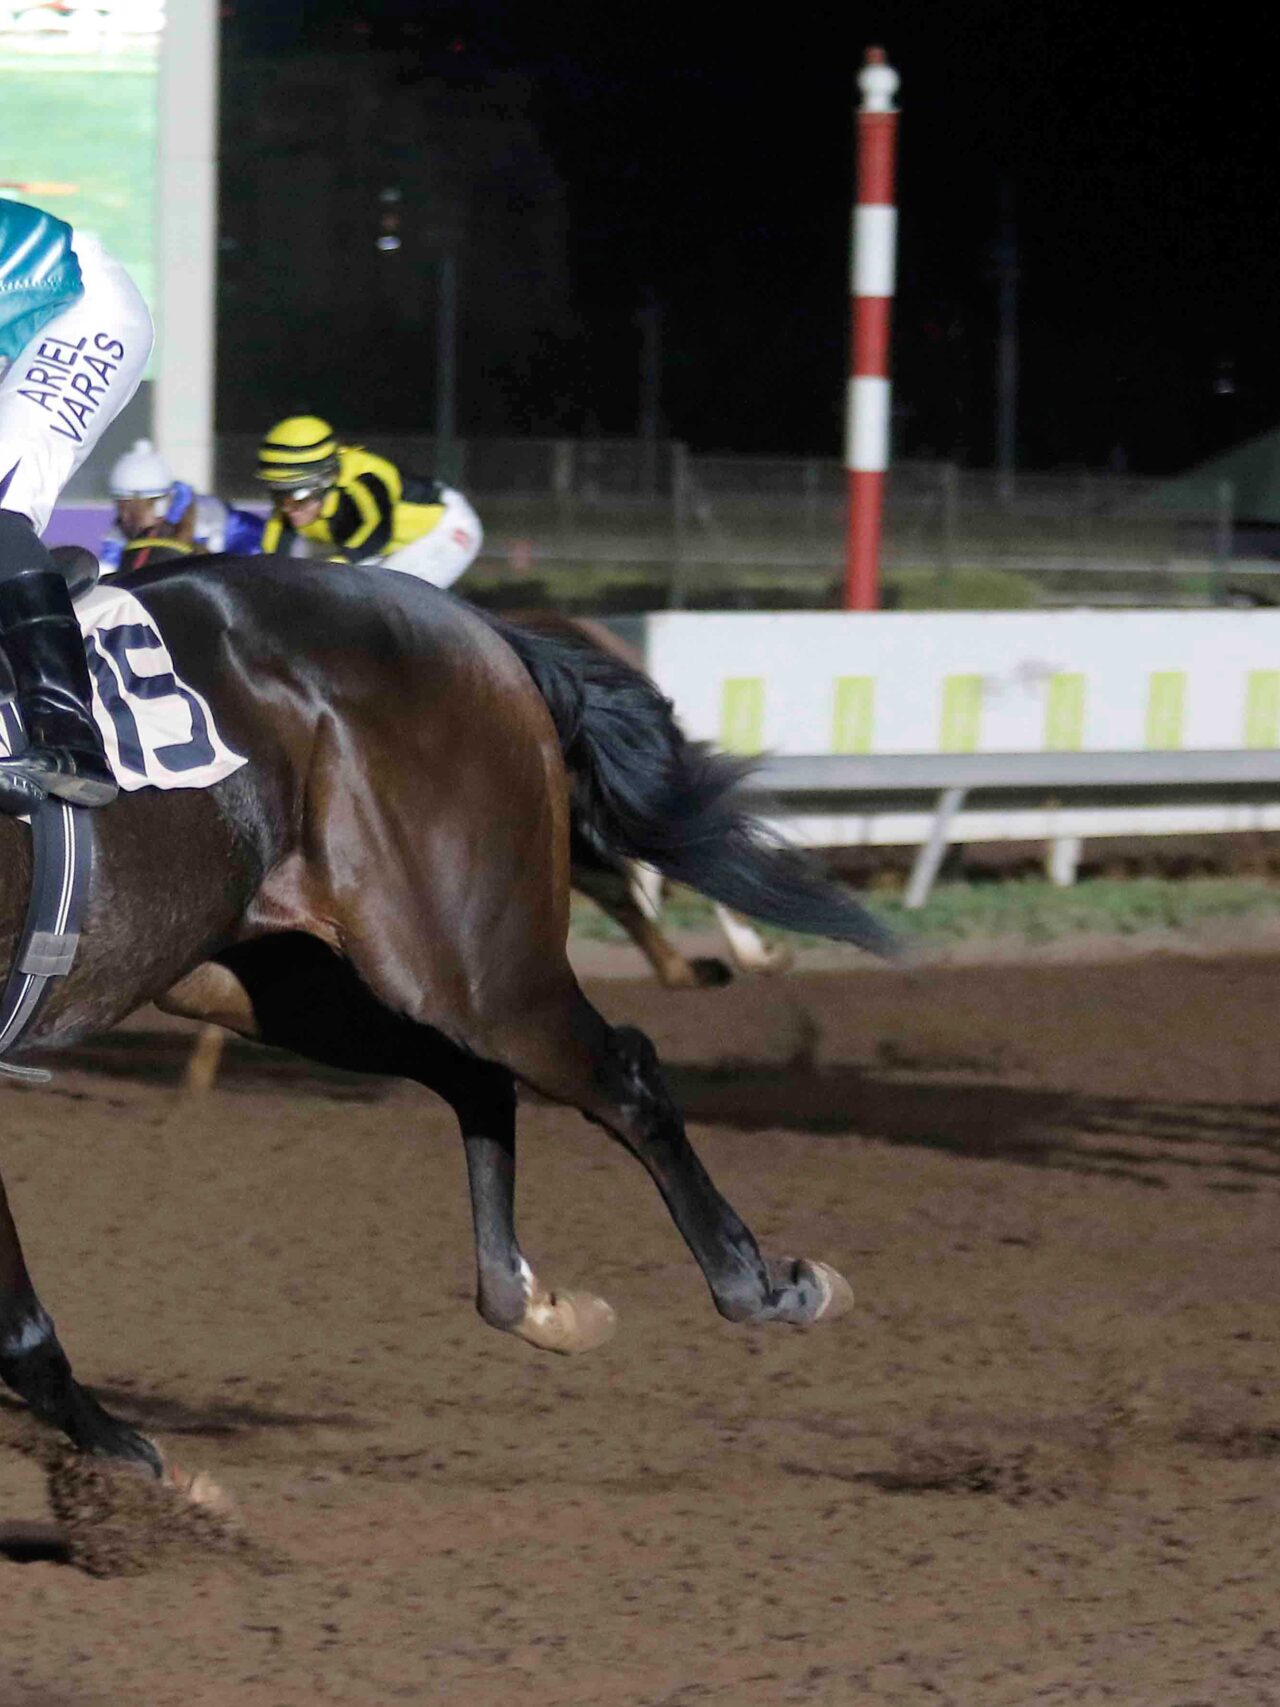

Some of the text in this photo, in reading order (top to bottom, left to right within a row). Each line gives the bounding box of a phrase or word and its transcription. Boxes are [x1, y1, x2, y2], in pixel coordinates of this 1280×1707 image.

[17, 337, 87, 413] ARIEL
[50, 332, 125, 443] VARAS
[83, 623, 216, 777] 15
